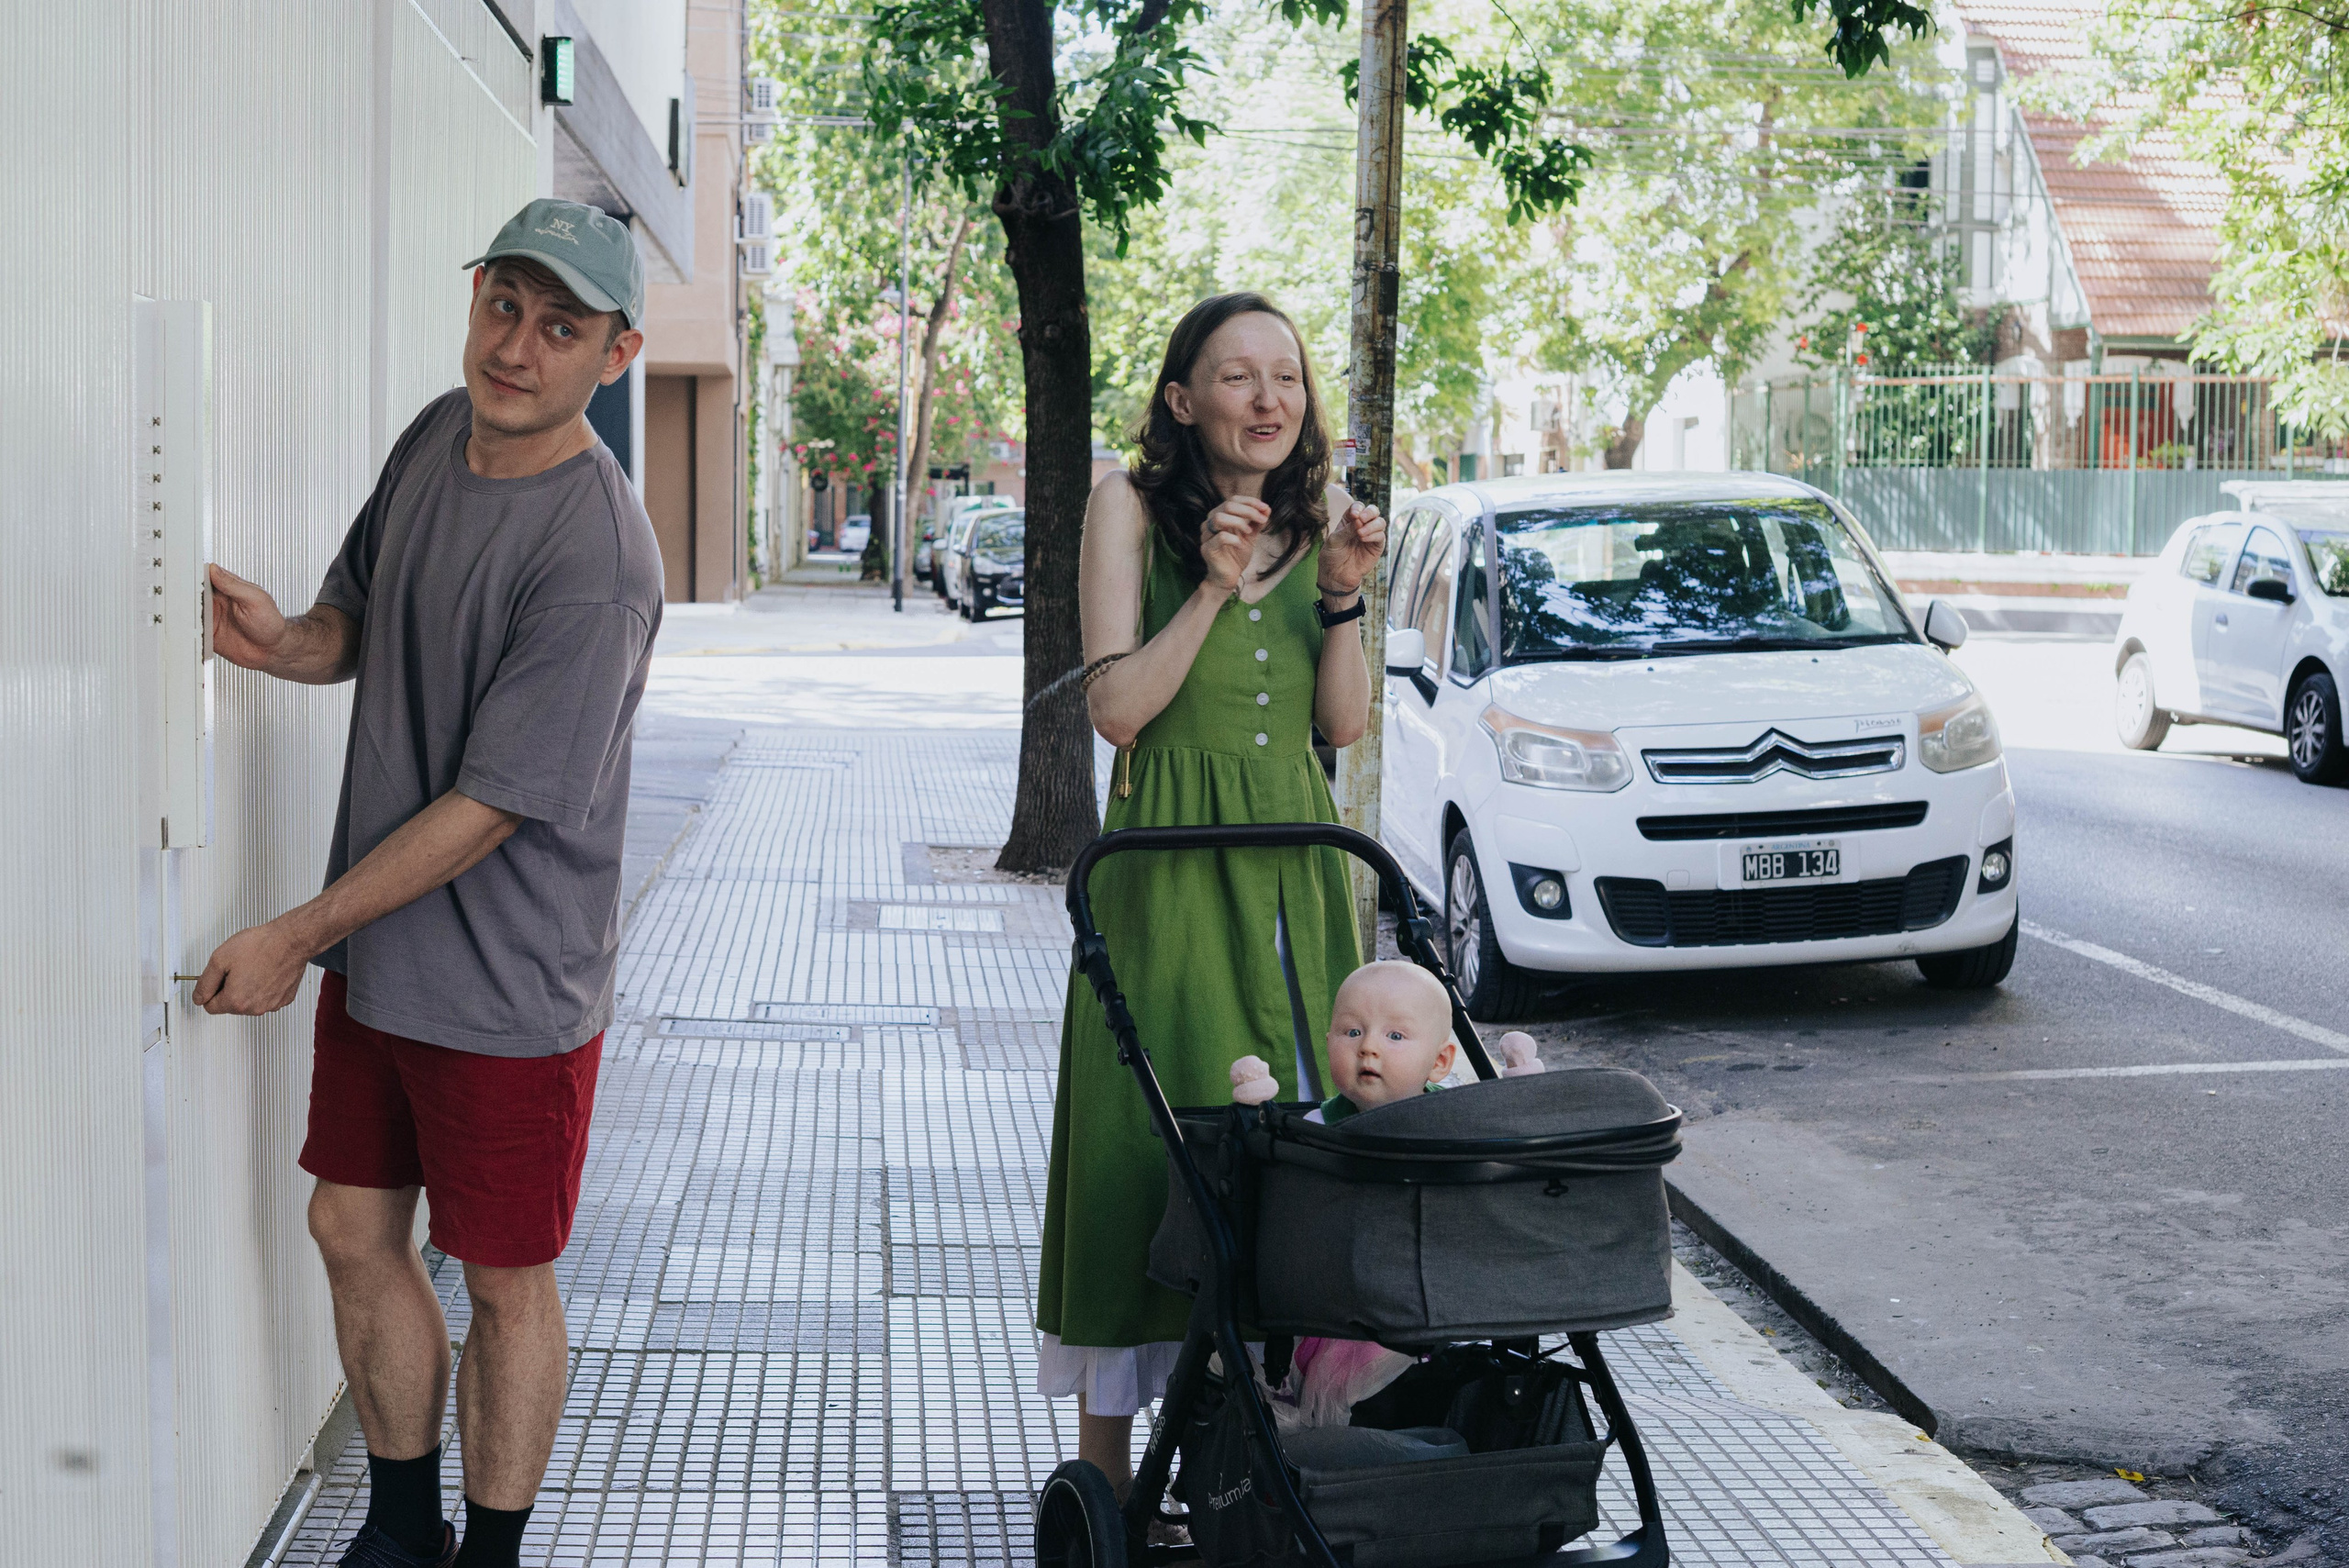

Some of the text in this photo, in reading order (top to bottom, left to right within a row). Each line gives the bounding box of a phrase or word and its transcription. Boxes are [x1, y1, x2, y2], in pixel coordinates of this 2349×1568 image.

[550, 217, 575, 232] NY
[1745, 850, 1838, 880] MBB 134
